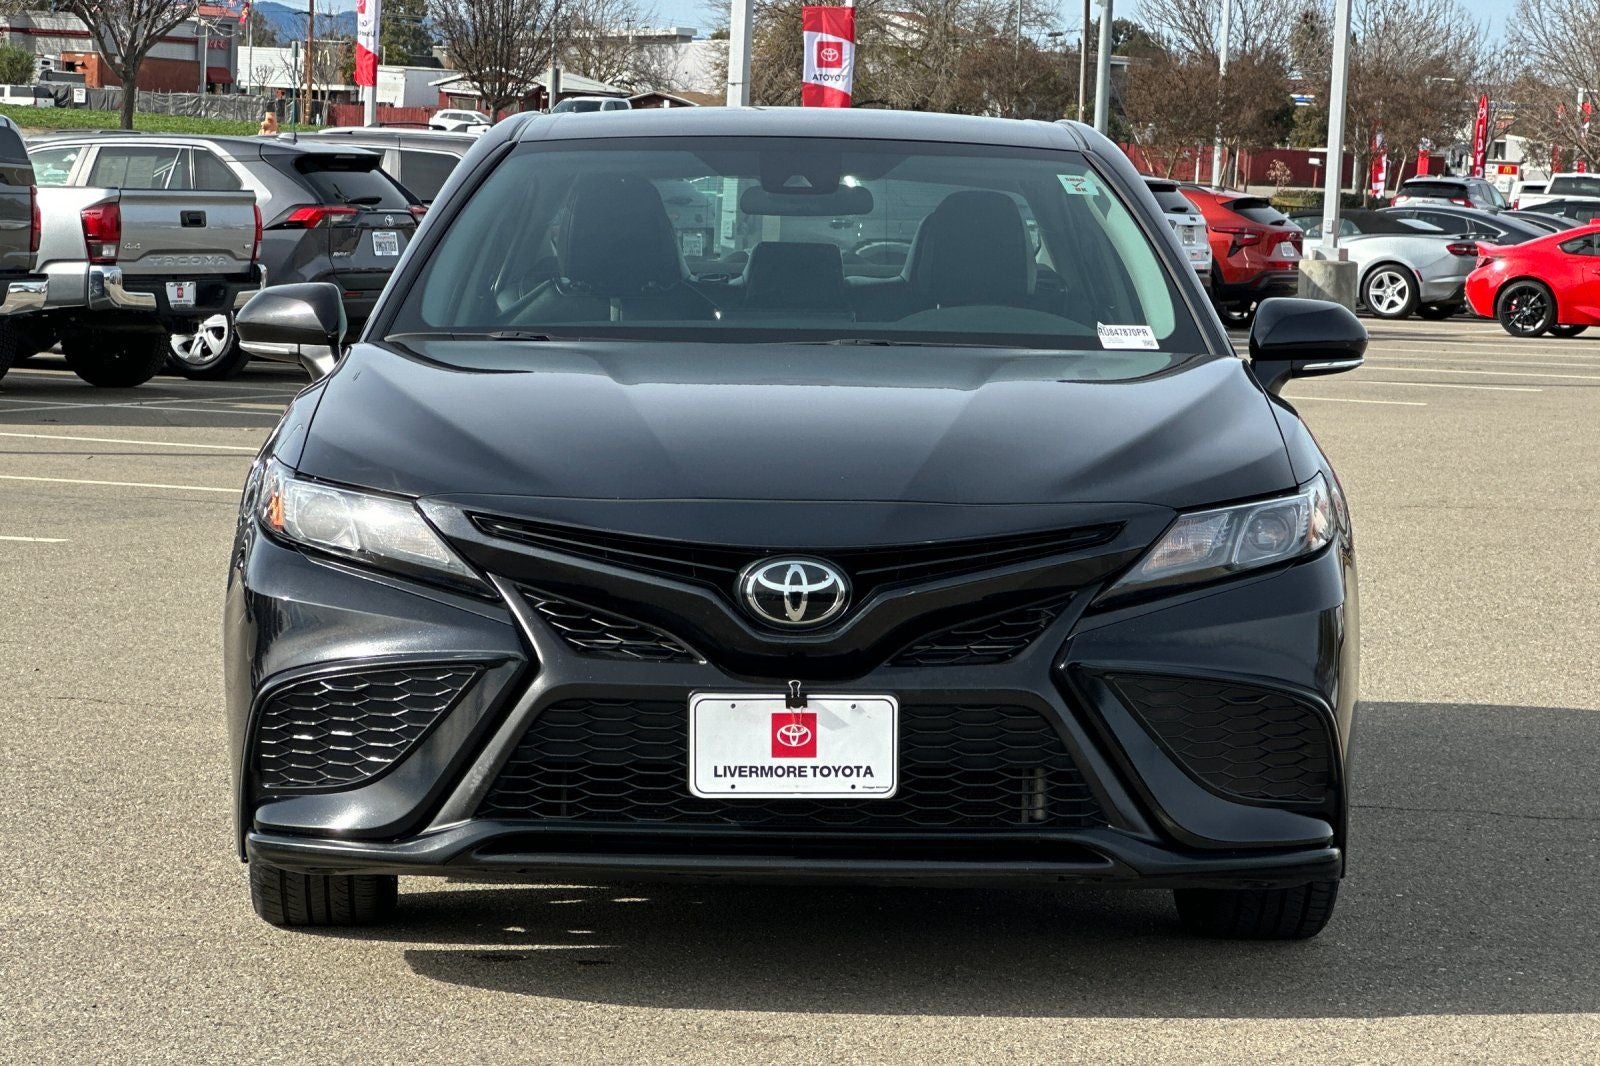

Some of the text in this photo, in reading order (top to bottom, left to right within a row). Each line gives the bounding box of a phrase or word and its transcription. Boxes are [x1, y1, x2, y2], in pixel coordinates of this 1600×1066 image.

[149, 256, 228, 266] TACOMA
[713, 765, 874, 778] LIVERMORE TOYOTA
